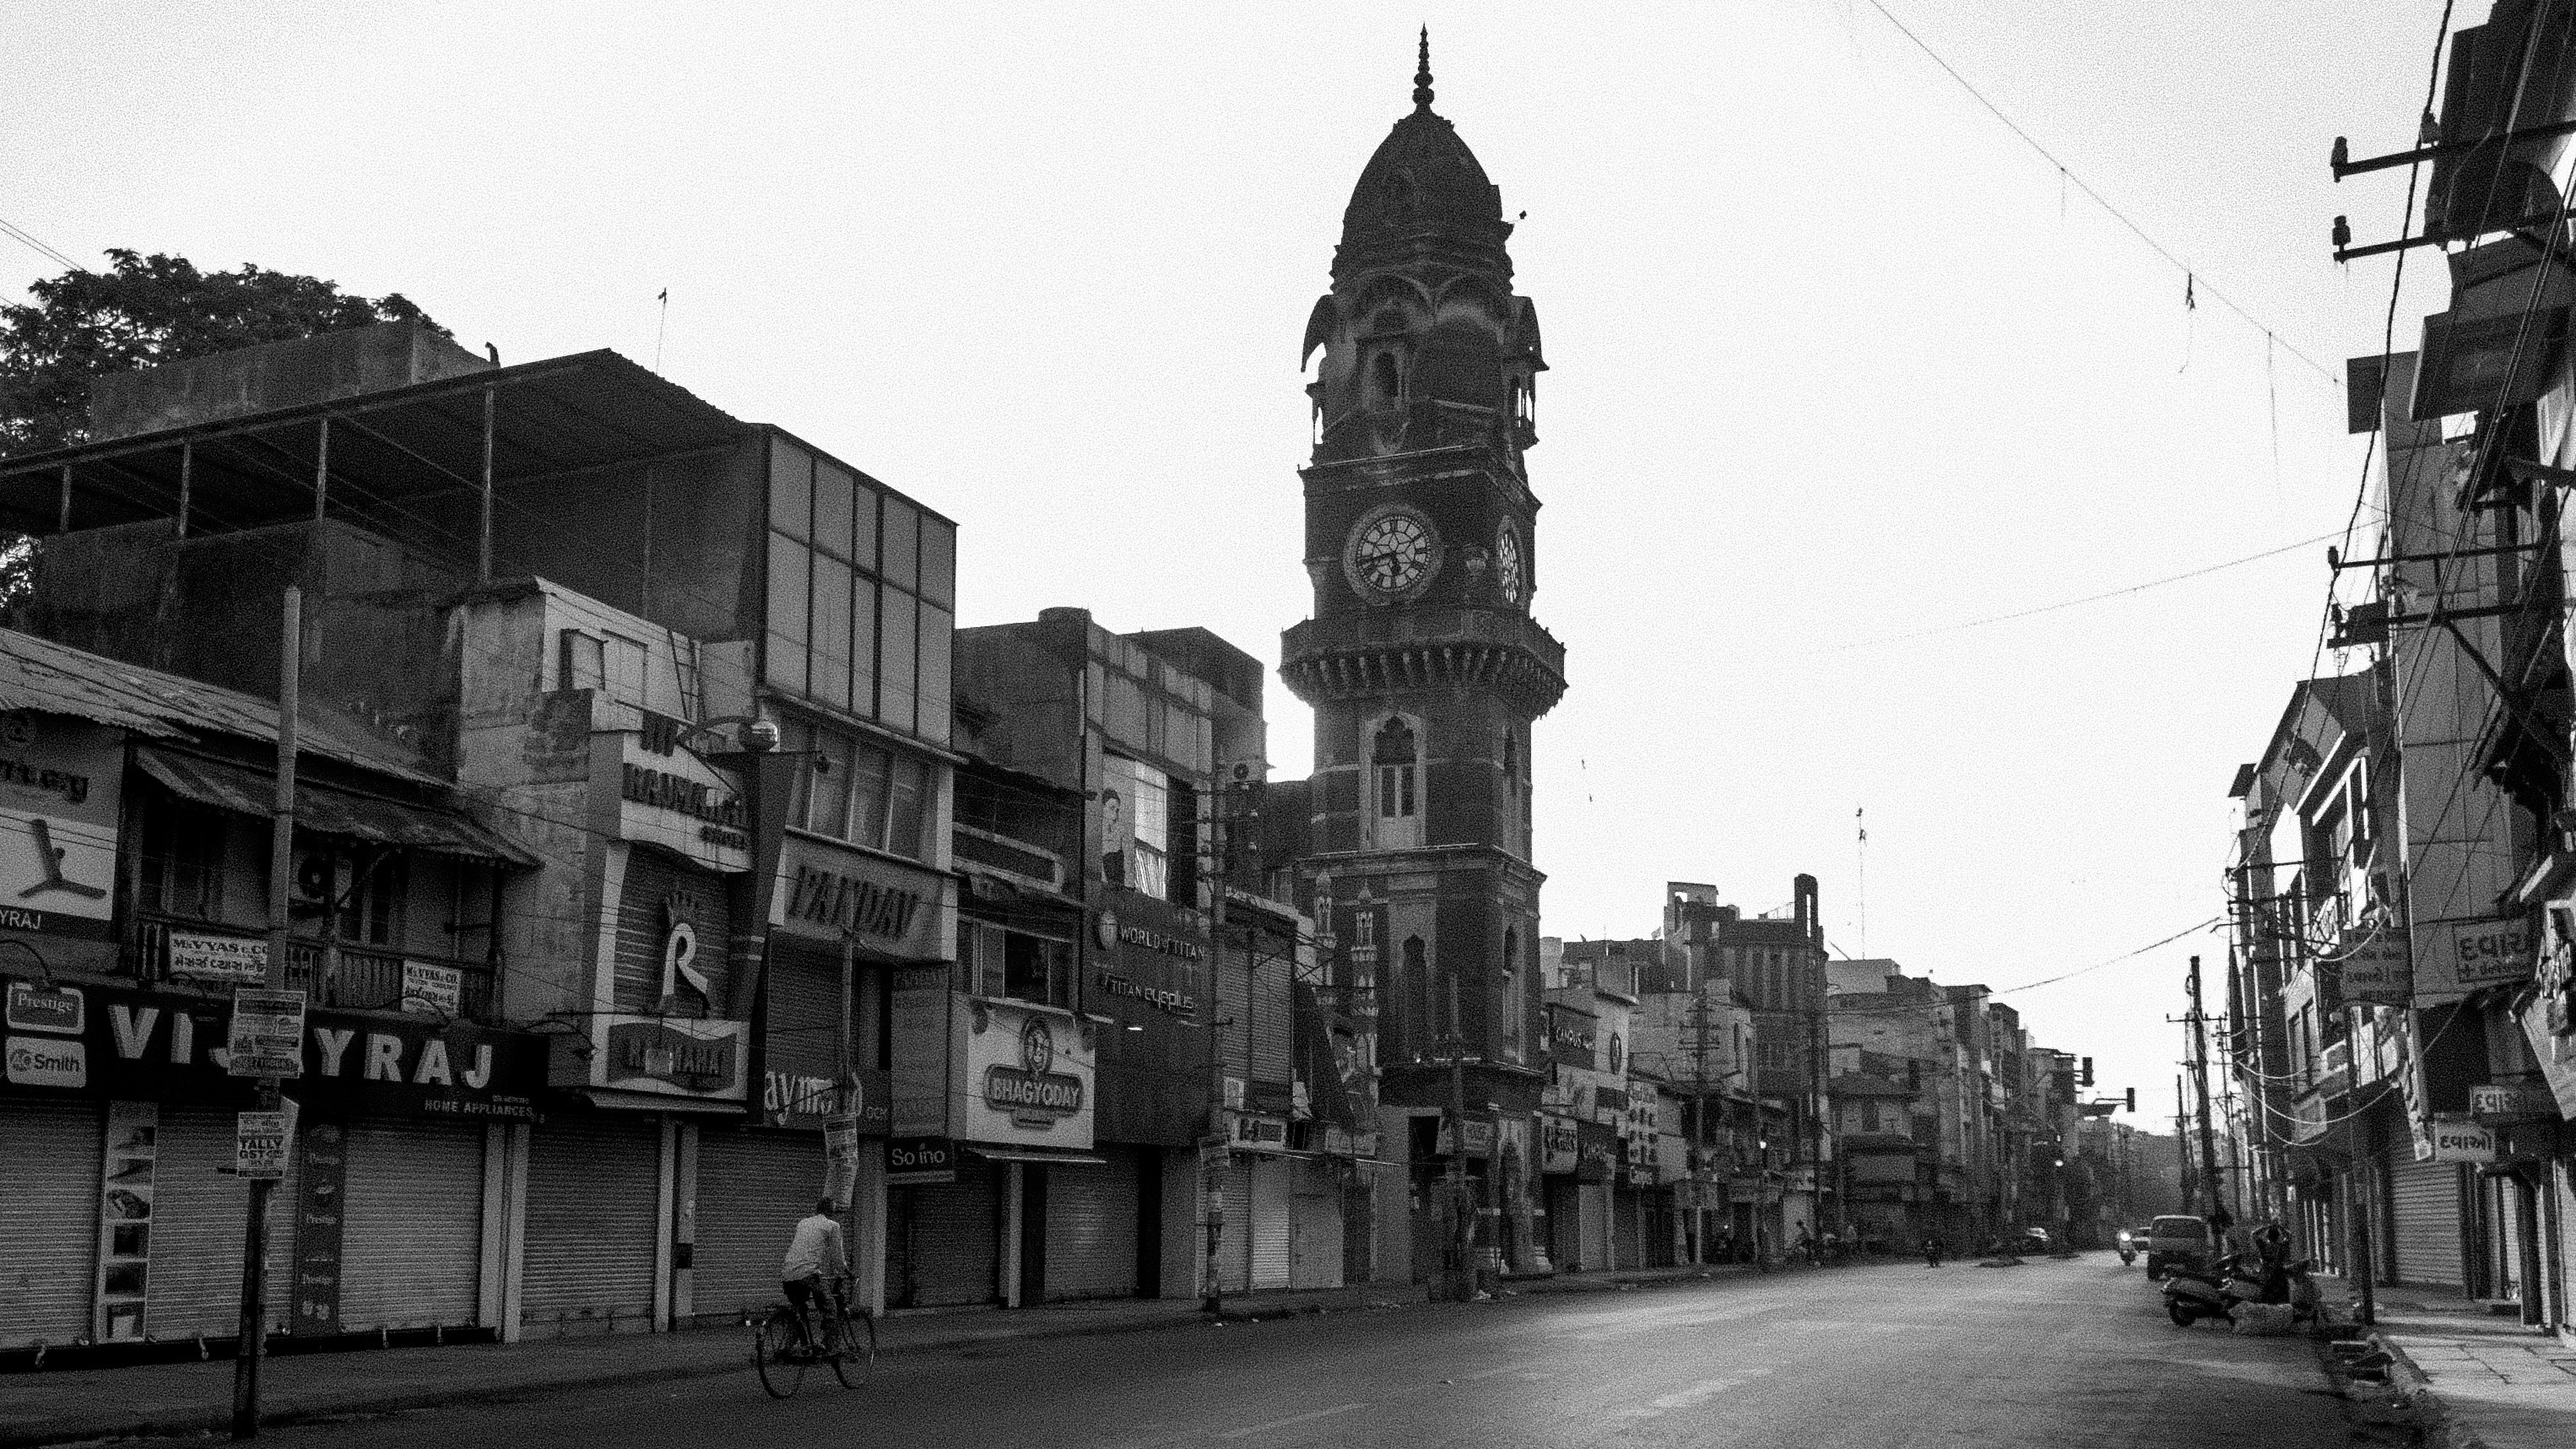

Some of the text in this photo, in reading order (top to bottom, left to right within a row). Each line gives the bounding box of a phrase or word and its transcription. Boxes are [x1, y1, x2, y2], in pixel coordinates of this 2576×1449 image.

[1119, 925, 1161, 949] WORLD
[1173, 938, 1206, 960] TITAN
[1110, 979, 1142, 997] TITAN
[17, 992, 75, 1015] Prestige
[107, 1003, 493, 1089] VIYRAJ
[34, 1052, 80, 1073] Smith
[990, 1076, 1080, 1109] BHAGYODAY
[424, 1099, 534, 1119] HOME APPLIANCES
[238, 1135, 284, 1149] TALLY
